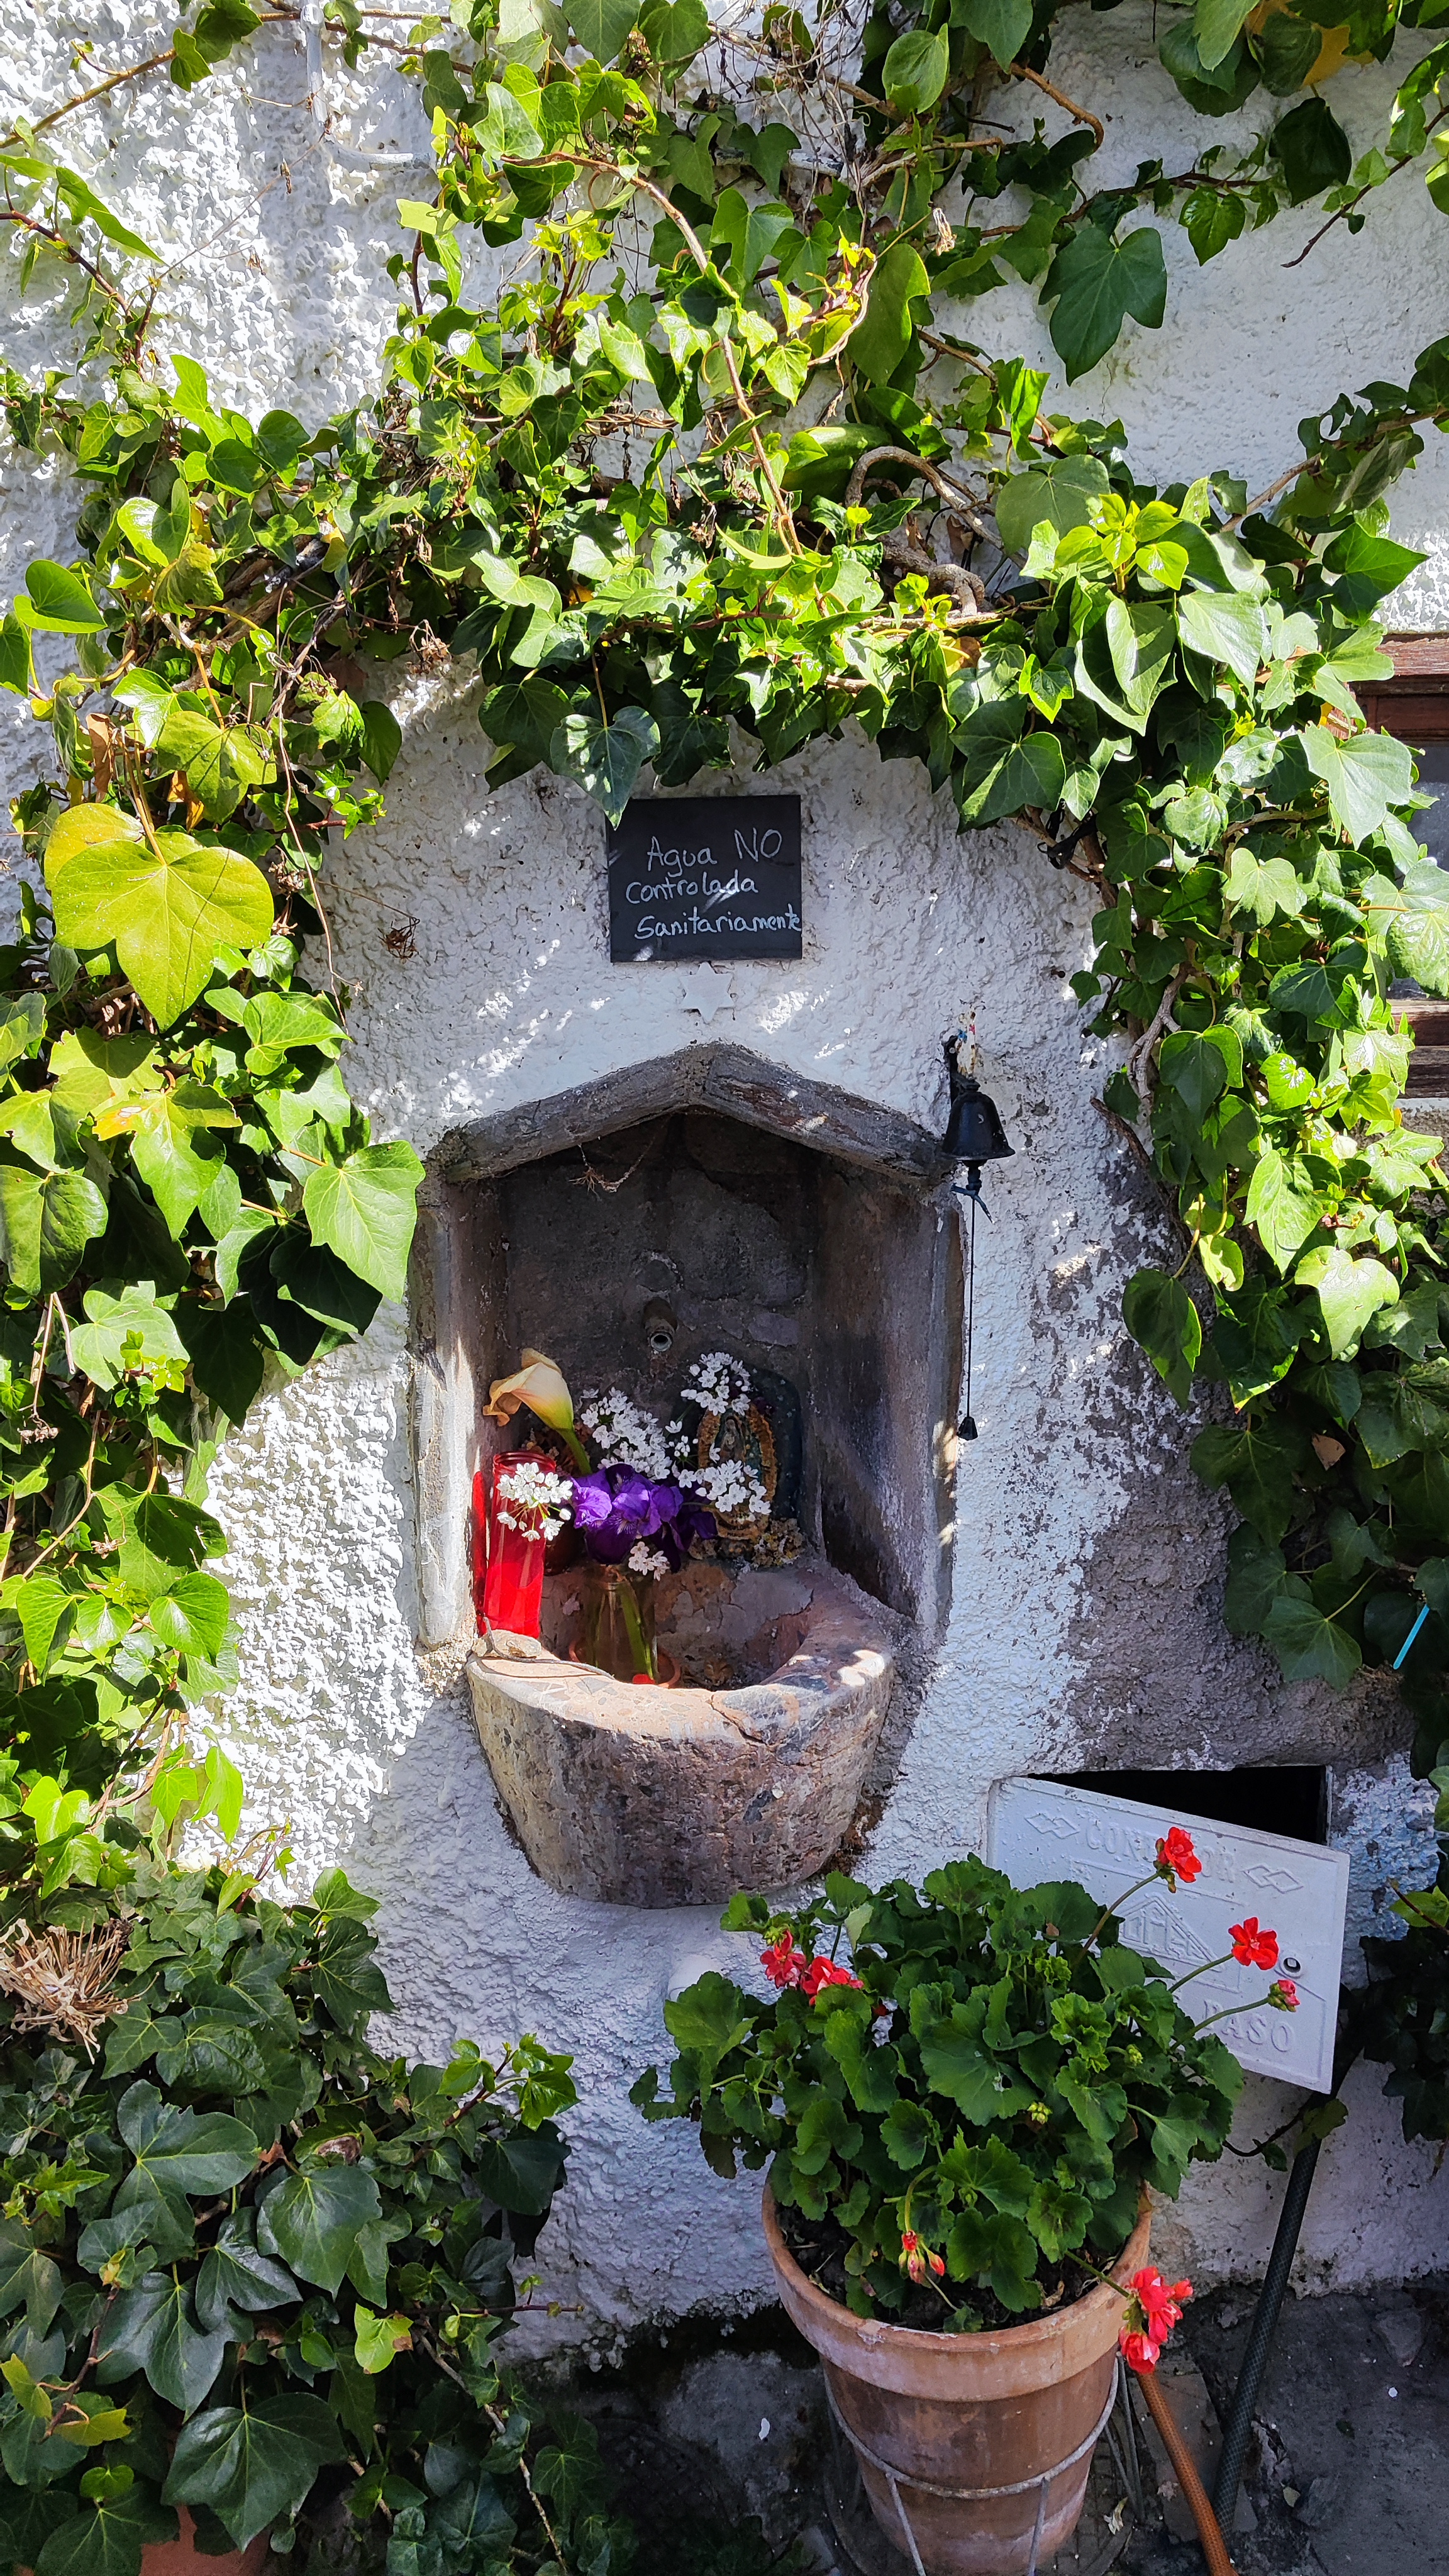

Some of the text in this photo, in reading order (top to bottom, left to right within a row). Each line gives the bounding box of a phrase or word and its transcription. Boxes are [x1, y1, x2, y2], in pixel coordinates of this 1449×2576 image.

[647, 827, 782, 878] Agua NO
[634, 903, 802, 940] Sanitariamente
